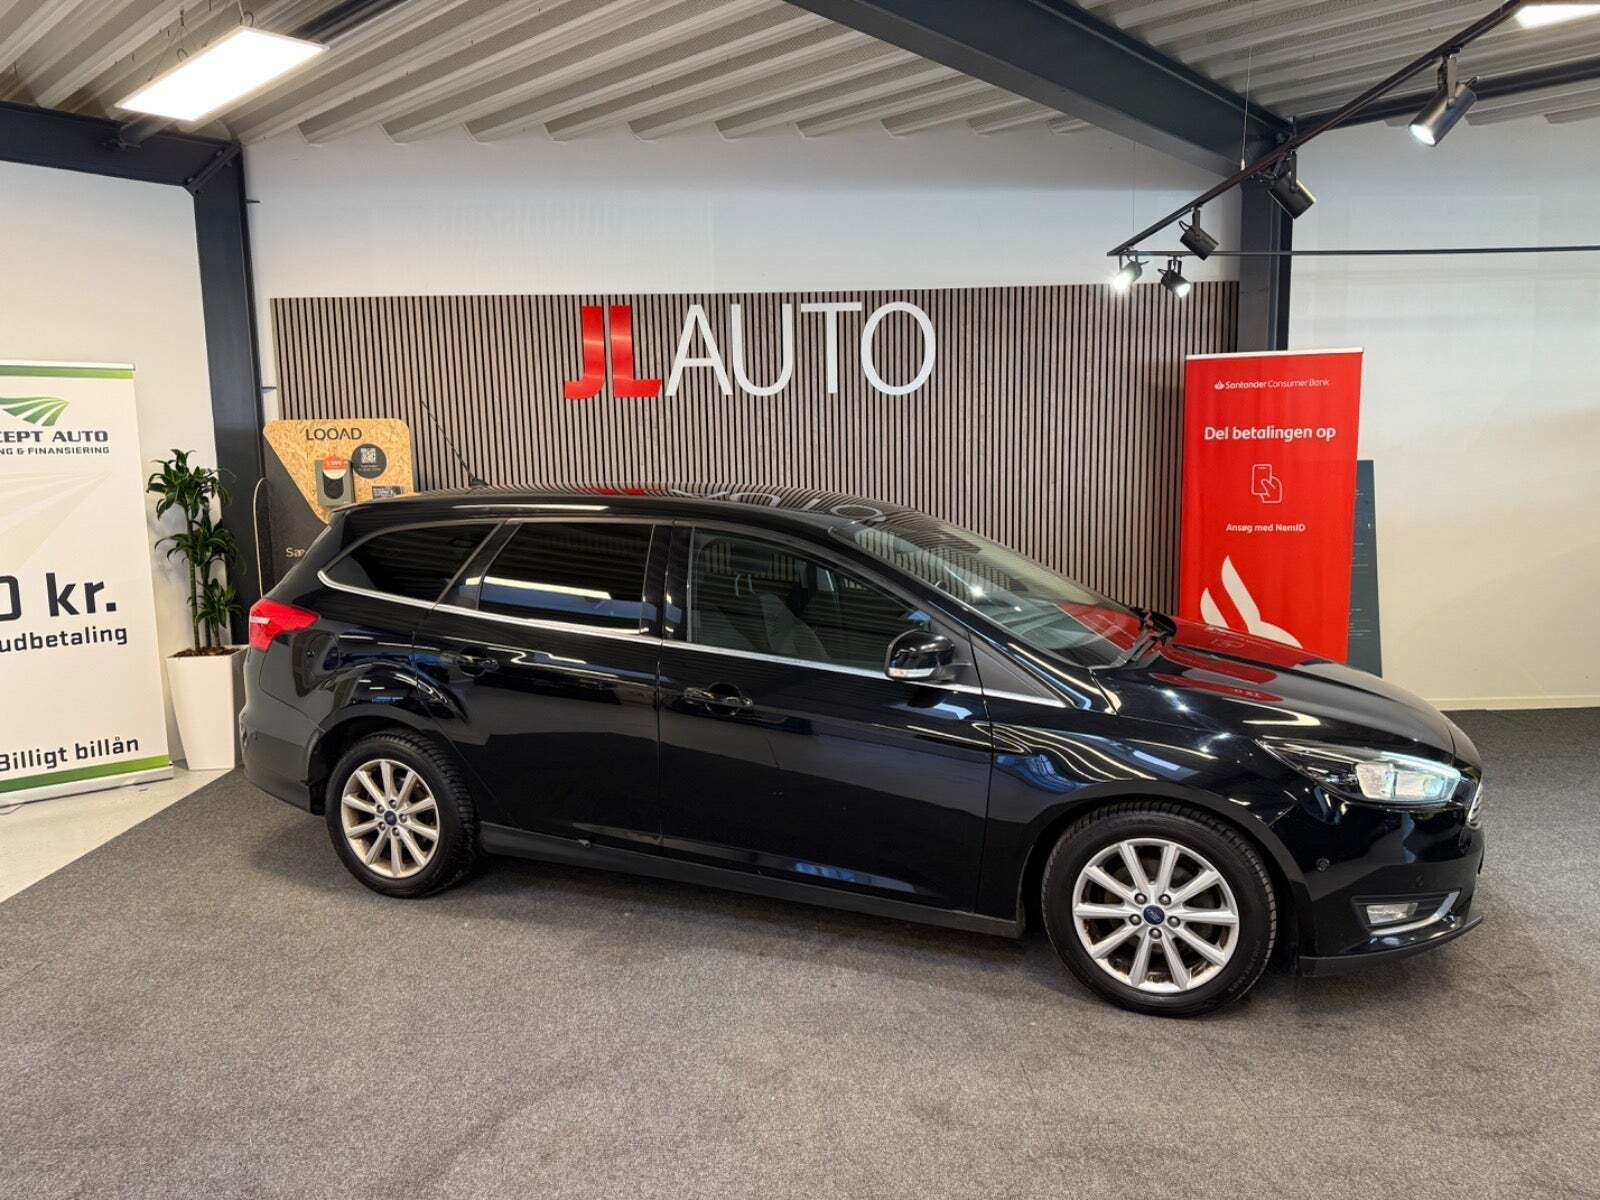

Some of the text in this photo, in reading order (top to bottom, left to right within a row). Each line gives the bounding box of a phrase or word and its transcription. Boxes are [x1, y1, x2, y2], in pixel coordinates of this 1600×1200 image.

[1225, 378, 1329, 390] Santander Consumer Bank
[0, 430, 109, 443] EPT AUTO
[305, 427, 362, 441] LOOAD
[1204, 425, 1336, 443] Del betalingen op
[27, 446, 110, 455] FINANSIERING
[1226, 523, 1306, 534] Ansøg med NemID
[45, 572, 117, 617] kr.
[0, 625, 128, 653] udbetaling
[0, 736, 139, 772] Billigt billån
